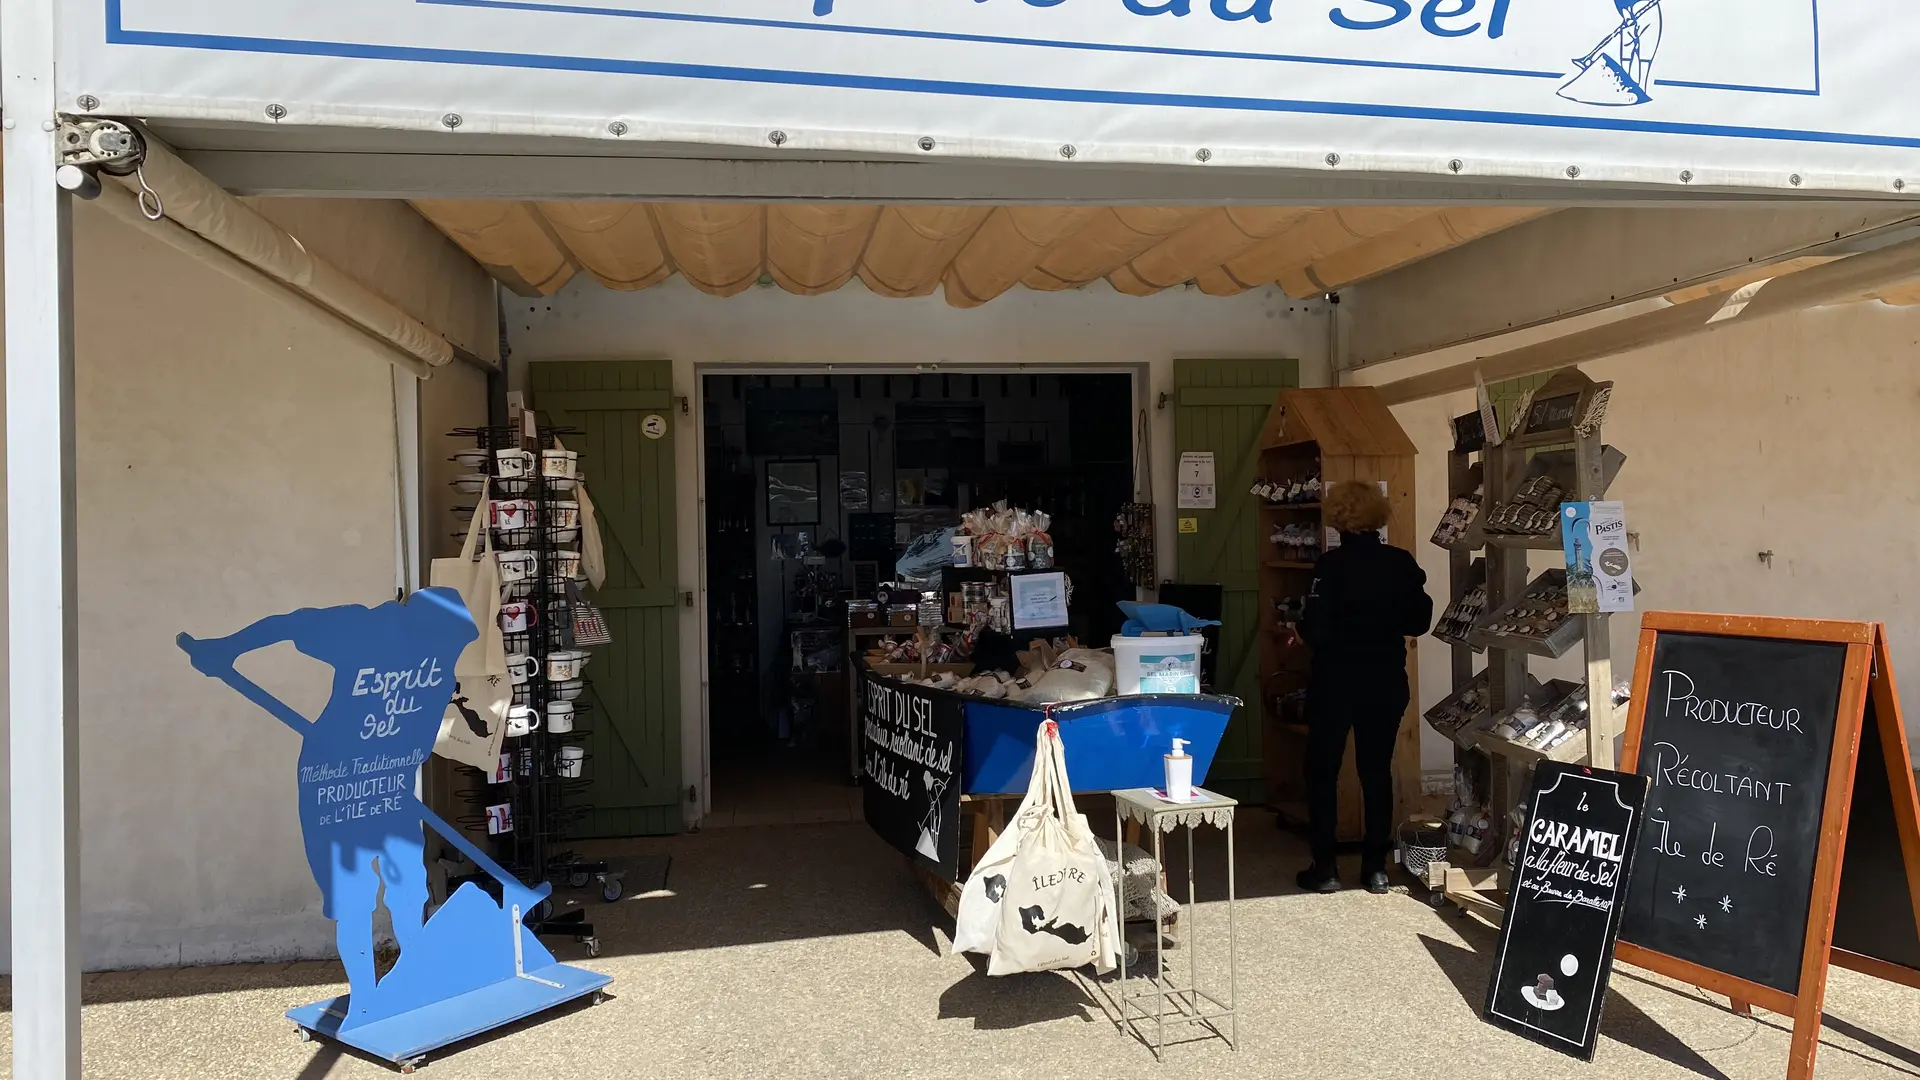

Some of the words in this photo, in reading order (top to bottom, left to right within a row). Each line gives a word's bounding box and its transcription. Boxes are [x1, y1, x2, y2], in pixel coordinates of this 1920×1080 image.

[1595, 520, 1623, 535] PASTIS
[352, 657, 442, 699] Esprit
[385, 690, 422, 716] du
[867, 680, 891, 722] ESPRIT
[896, 691, 910, 729] DU
[913, 696, 937, 738] SEL
[1661, 669, 1803, 734] PRODUCTEUR
[360, 714, 400, 740] Sel
[301, 760, 349, 784] Méthode
[352, 748, 424, 775] Traditionnelle
[925, 740, 937, 768] de
[936, 741, 953, 775] sel
[1653, 741, 1791, 805] RÉCOLTANT
[318, 774, 406, 805] PRODUCTEUR
[1576, 791, 1589, 812] le
[320, 814, 331, 825] DE
[335, 801, 366, 823] L'ÎLE
[370, 804, 381, 816] DE
[382, 792, 402, 811] RÉ
[1531, 818, 1622, 862] CARAMEL
[1650, 806, 1686, 858] Île
[1701, 822, 1724, 868] de
[1744, 825, 1777, 876] Ré
[1525, 845, 1535, 868] à
[1533, 848, 1550, 872] la
[1536, 851, 1579, 881] fleur
[1574, 860, 1590, 881] de
[1590, 861, 1618, 887] Sel
